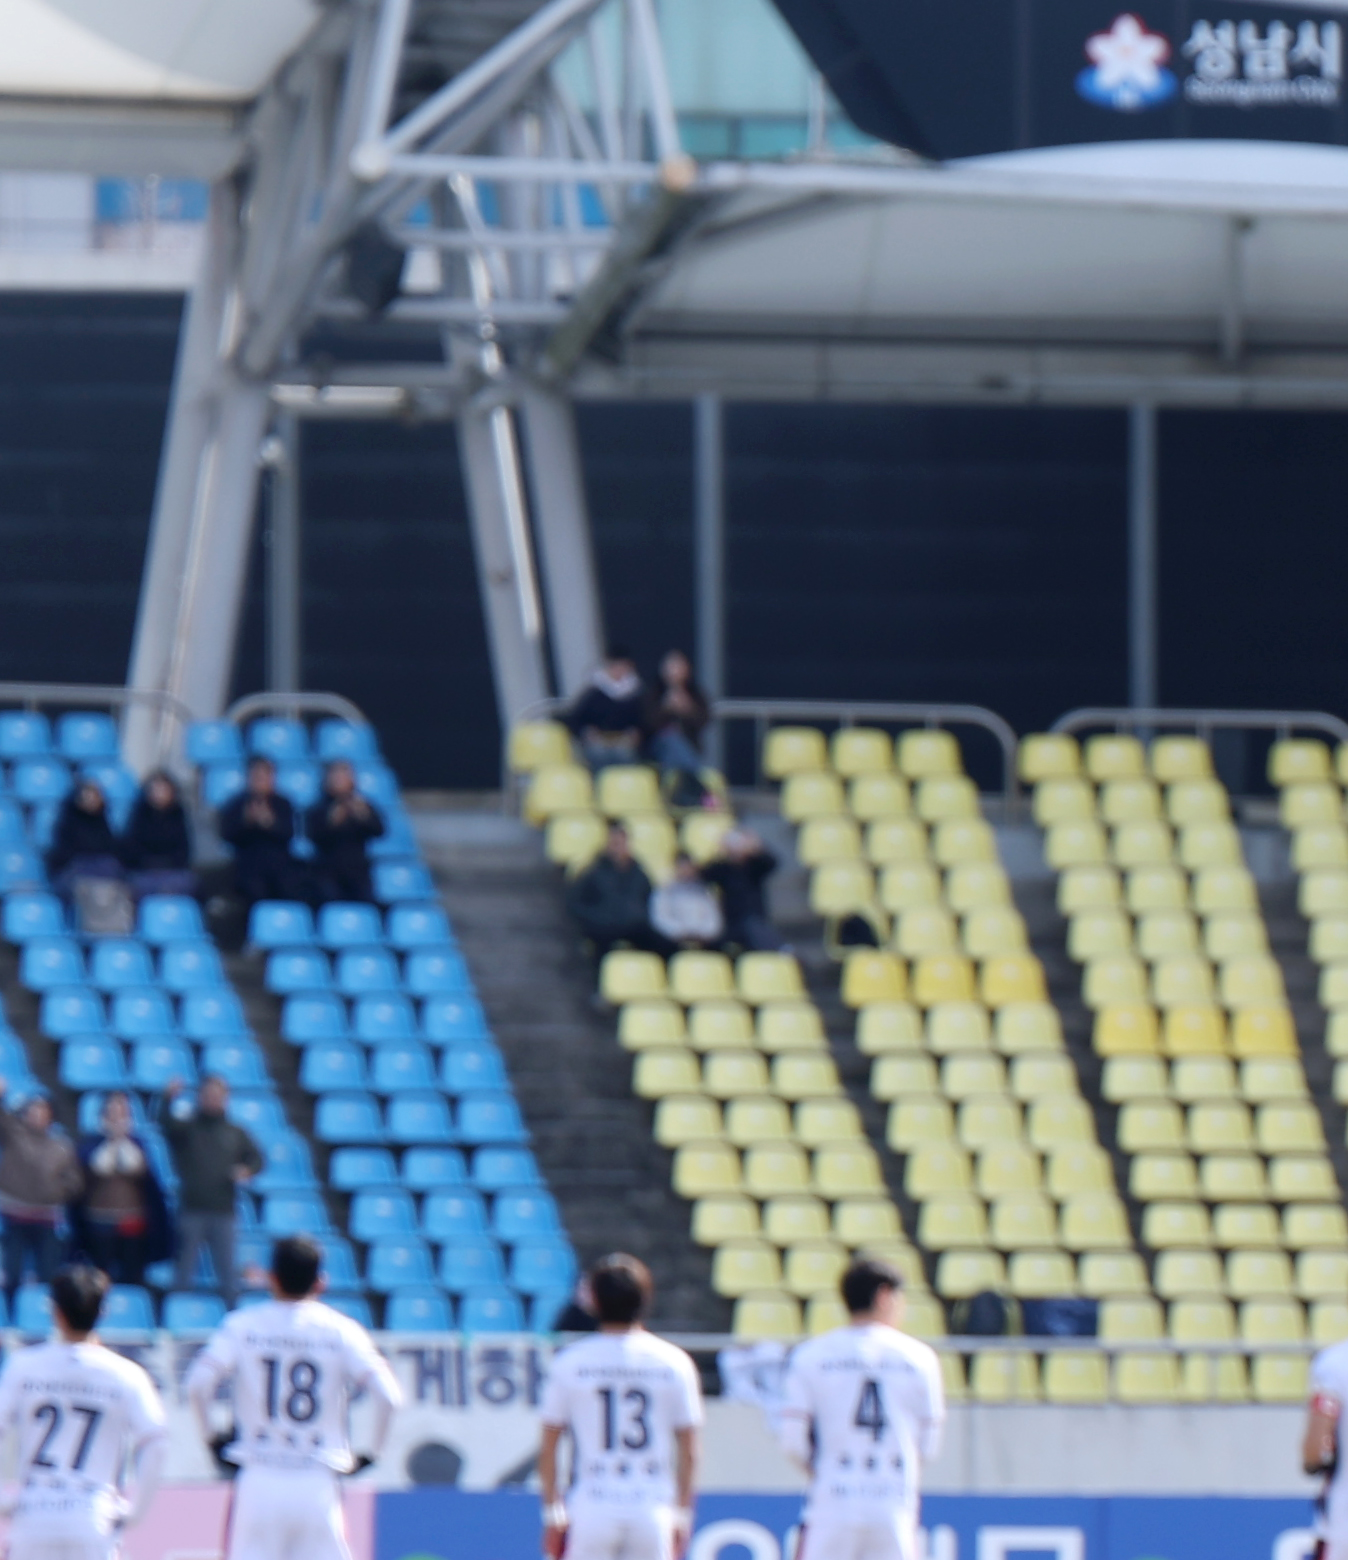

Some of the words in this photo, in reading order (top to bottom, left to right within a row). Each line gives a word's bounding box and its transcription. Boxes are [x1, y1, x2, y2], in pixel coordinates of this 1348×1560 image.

[1182, 19, 1342, 79] 성남시
[260, 1355, 318, 1423] 18
[597, 1387, 650, 1451] 13
[854, 1377, 887, 1443] 4
[32, 1402, 103, 1471] 27
